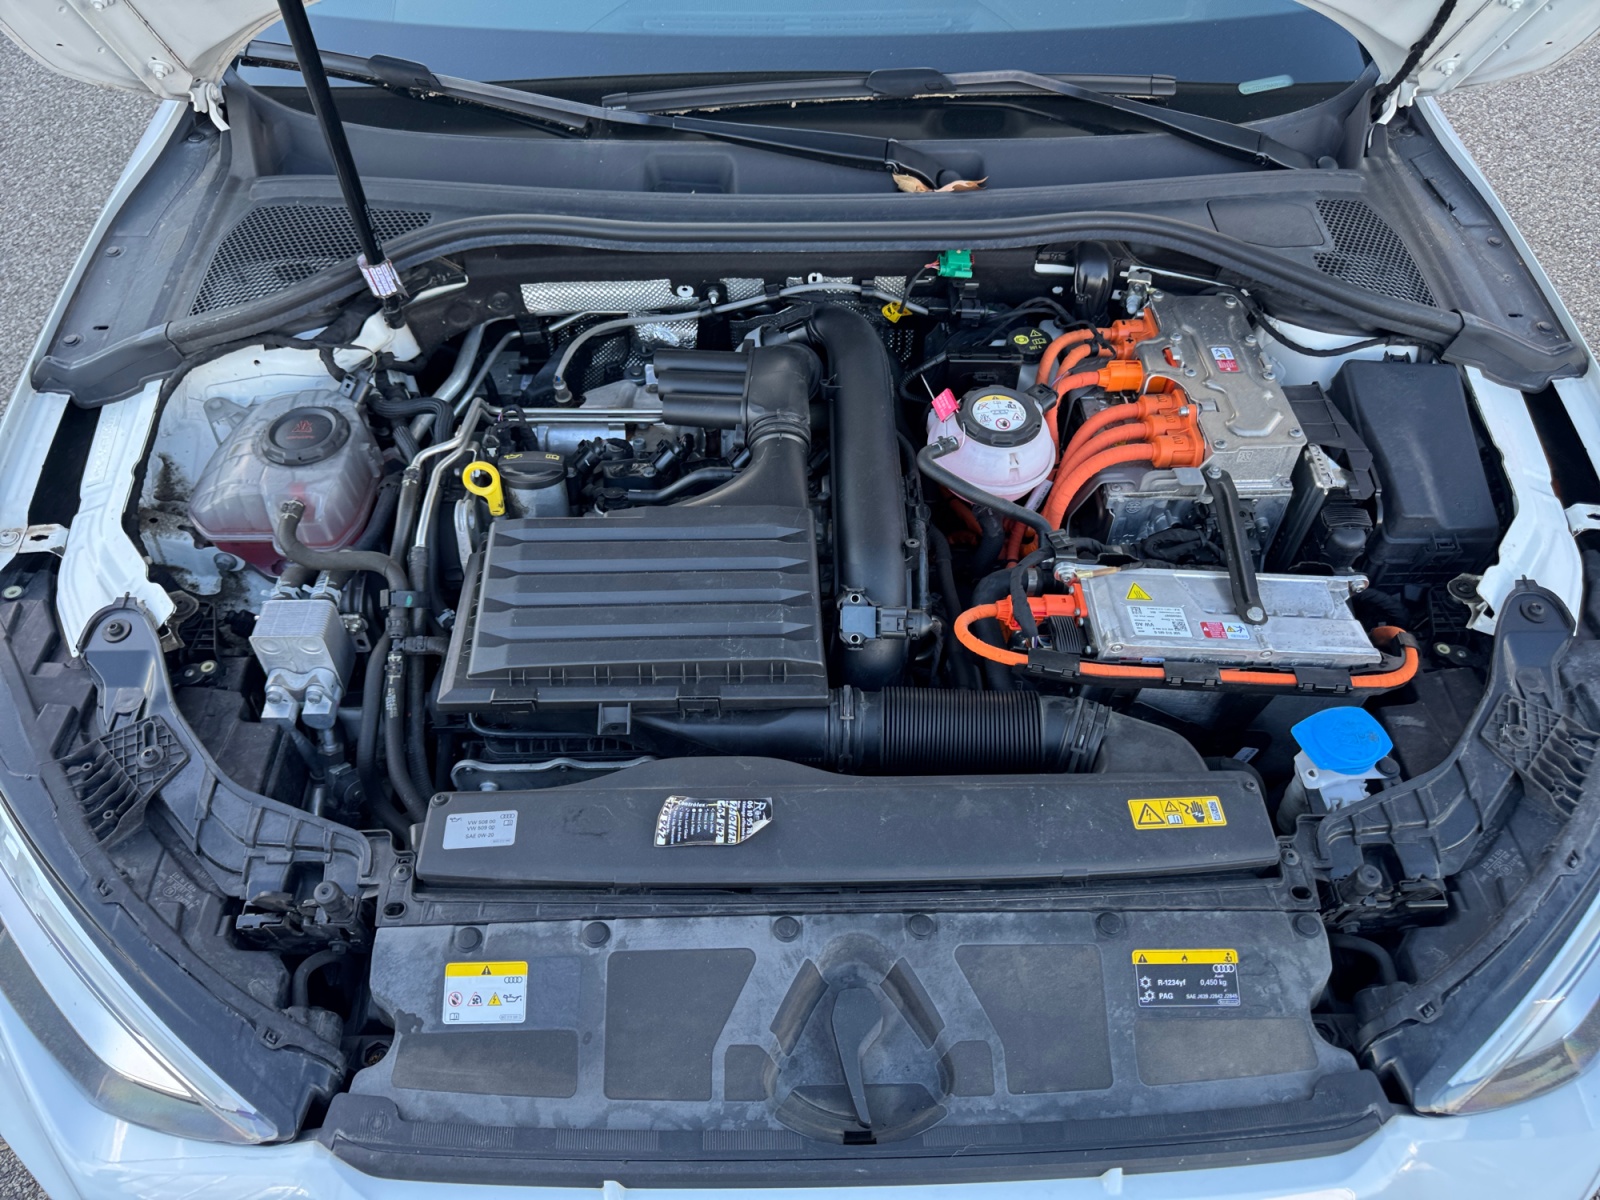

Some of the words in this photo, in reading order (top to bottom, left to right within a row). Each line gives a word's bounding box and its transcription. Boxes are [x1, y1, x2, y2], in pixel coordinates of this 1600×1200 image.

[747, 800, 753, 809] 06
[747, 818, 753, 826] 95
[1157, 979, 1186, 987] R-1234yf
[1219, 979, 1227, 987] kg
